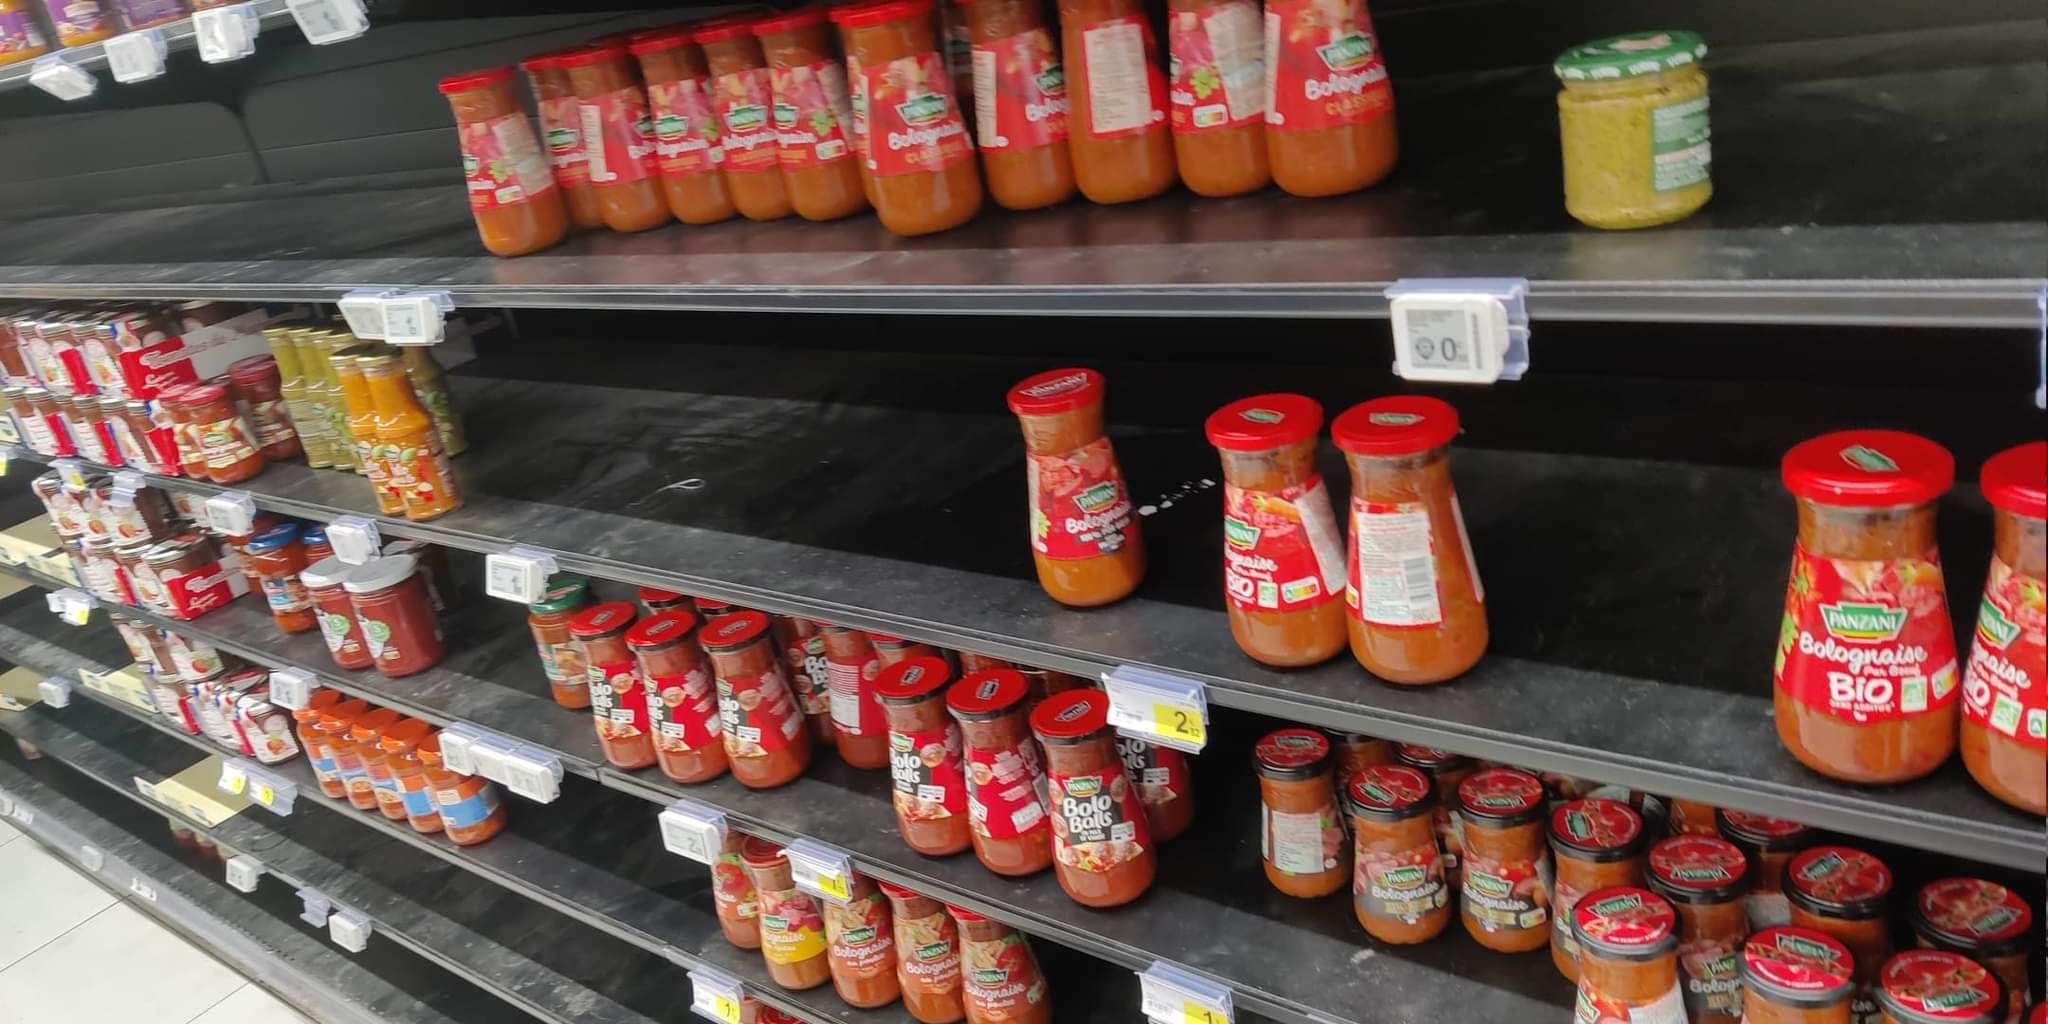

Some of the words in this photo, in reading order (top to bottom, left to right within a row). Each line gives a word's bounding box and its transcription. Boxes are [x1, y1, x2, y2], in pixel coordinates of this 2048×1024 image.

[1829, 610, 1896, 631] PANZANI
[1799, 631, 1928, 676] Bolognaise
[1174, 711, 1189, 734] 2
[1063, 795, 1112, 818] Bolo
[1069, 811, 1113, 834] Balls
